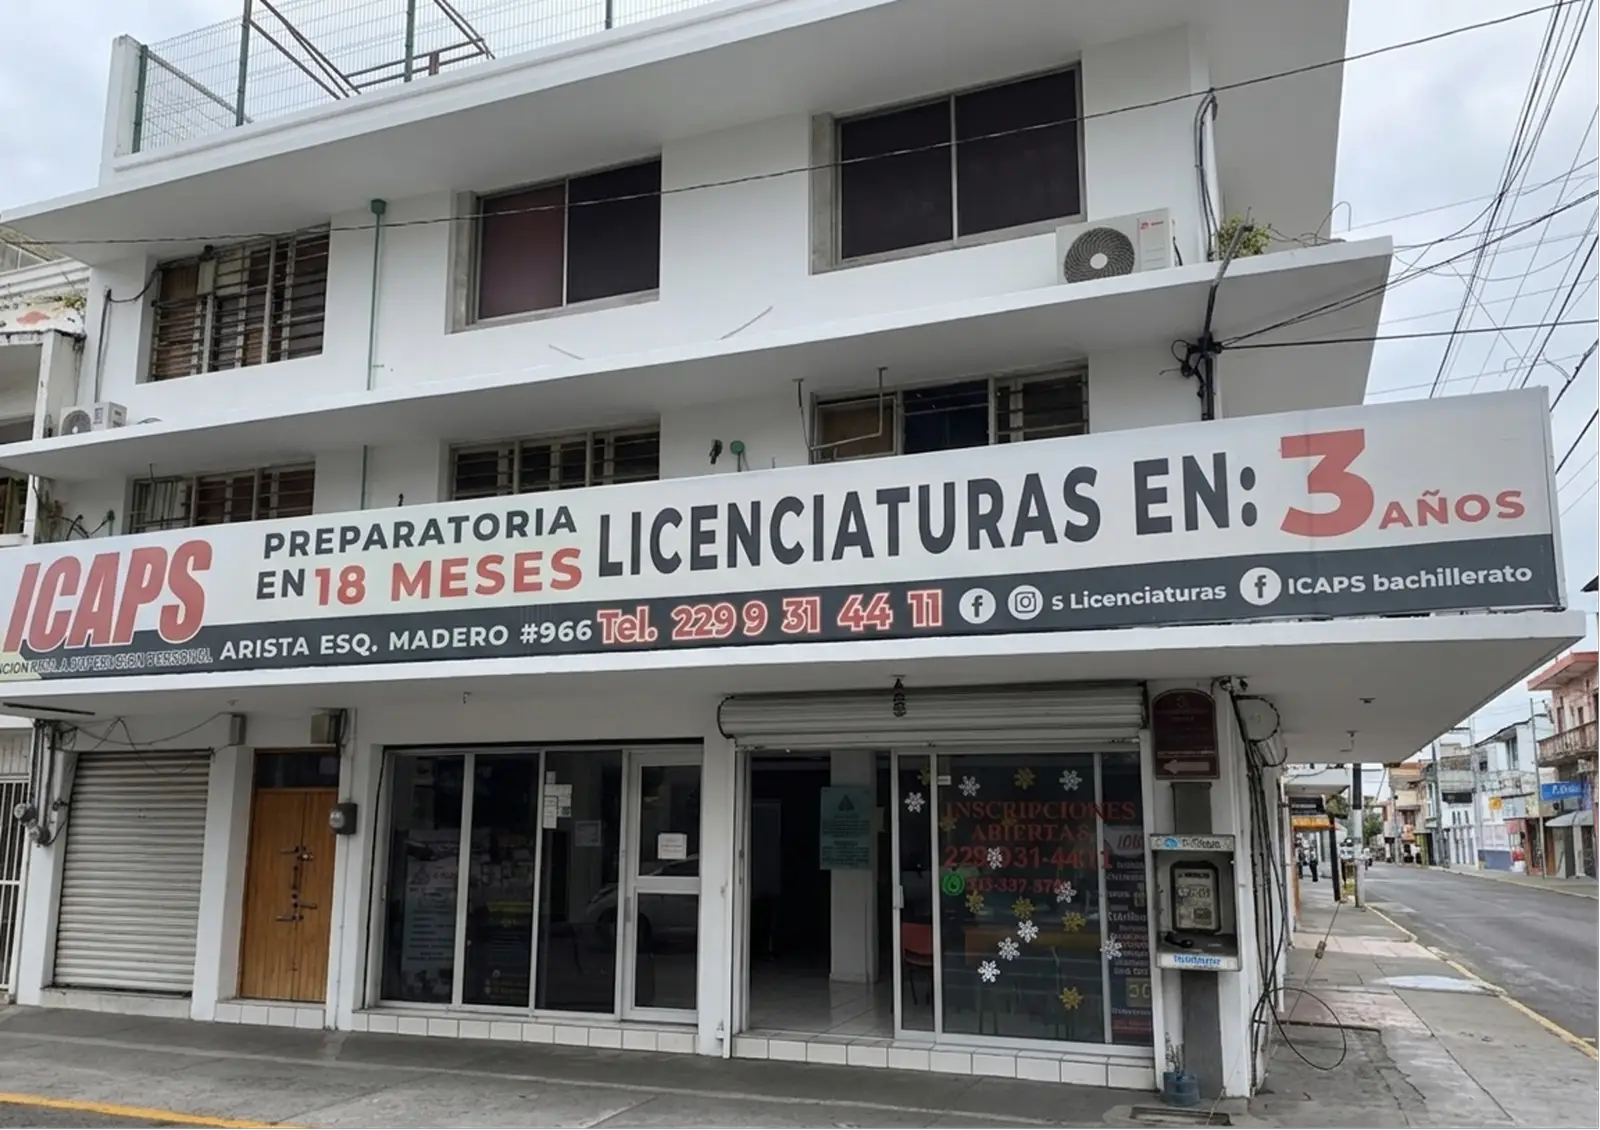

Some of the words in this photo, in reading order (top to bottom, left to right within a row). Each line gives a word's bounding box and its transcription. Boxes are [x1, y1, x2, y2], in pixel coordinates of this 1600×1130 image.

[598, 466, 1101, 577] LICENCIATURAS
[1133, 452, 1258, 536] EN:
[1278, 428, 1375, 538] 3
[1379, 489, 1526, 530] AÑOS
[264, 505, 577, 559] PREPARATORIA
[3, 539, 213, 655] ICAPS
[256, 568, 305, 600] EN
[315, 564, 366, 606] 18
[391, 548, 582, 601] MESES
[1069, 582, 1227, 610] Licenciaturas
[1288, 574, 1366, 595] ICAPS
[1373, 565, 1533, 592] bachillerato
[220, 635, 309, 661] ARISTA
[320, 631, 378, 656] ESQ.
[390, 624, 509, 651] MADERO
[519, 619, 593, 644] #966
[597, 605, 658, 645] Tel.
[781, 596, 821, 634] 31
[837, 592, 894, 631] 44
[907, 588, 942, 628] 11
[946, 801, 1136, 820] INSCRIPCIONES
